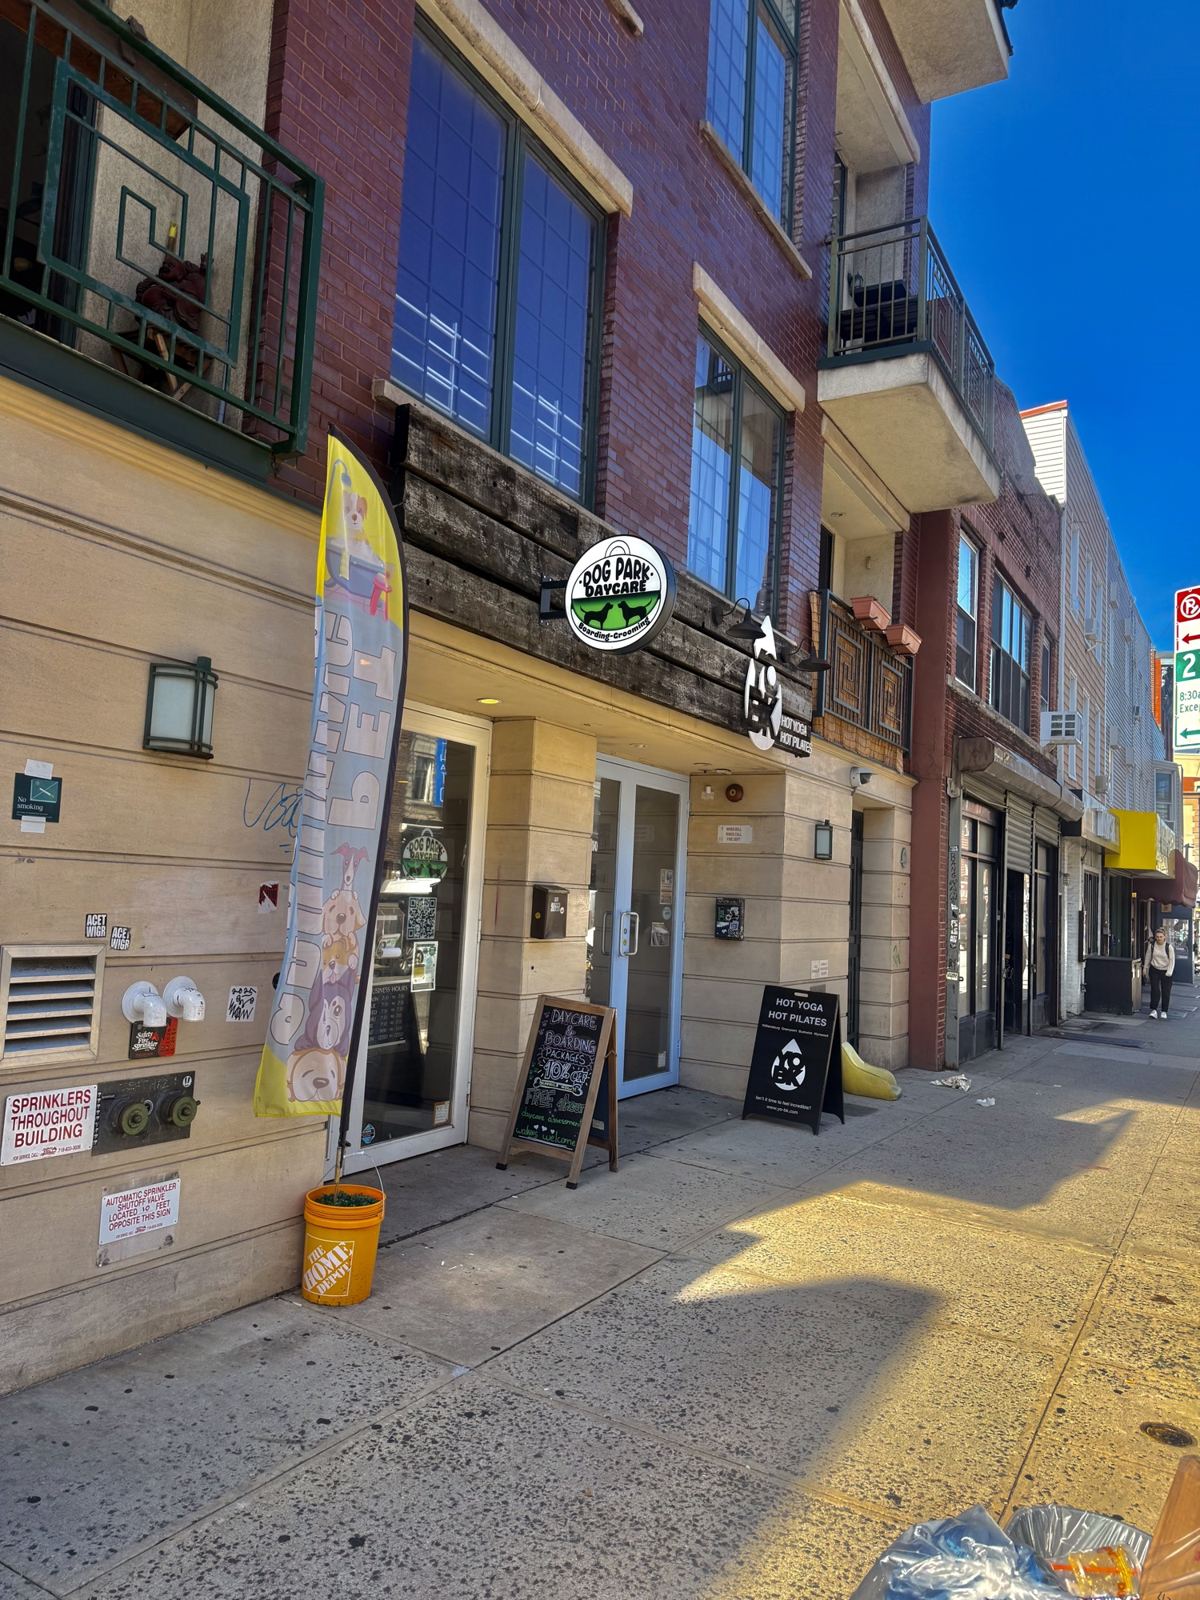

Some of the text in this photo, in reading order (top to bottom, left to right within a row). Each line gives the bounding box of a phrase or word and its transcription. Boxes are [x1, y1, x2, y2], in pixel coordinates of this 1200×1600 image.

[583, 557, 650, 587] DOG PARK
[585, 580, 647, 597] DAYCARE
[1182, 653, 1196, 679] 2
[1180, 703, 1200, 714] Exce
[781, 714, 807, 737] HOT YOGA
[779, 730, 812, 754] HOT PILATES
[17, 803, 44, 812] smoking
[775, 997, 824, 1013] HOT YOGA
[551, 1008, 597, 1031] DAYCARE
[768, 1010, 828, 1027] HOT PILATES
[544, 1030, 597, 1053] BOARDING
[565, 1025, 576, 1037] &
[545, 1049, 586, 1065] PACKAGES
[543, 1059, 572, 1080] 10%
[11, 1088, 92, 1114] SPRINKLERS
[11, 1105, 90, 1131] THROUGHOUT
[14, 1123, 83, 1148] BUILDING
[106, 1182, 177, 1207] AUTOMATIC SPRINKLER
[117, 1193, 165, 1212] SHUTOFF VALVE
[109, 1208, 138, 1222] LOCATED
[156, 1200, 170, 1210] FEET
[109, 1216, 140, 1232] OPPOSITE
[142, 1212, 155, 1222] THIS
[156, 1208, 171, 1219] SIGN
[304, 1241, 353, 1290] HOME
[307, 1245, 327, 1265] THE
[316, 1261, 351, 1295] DEPOT
